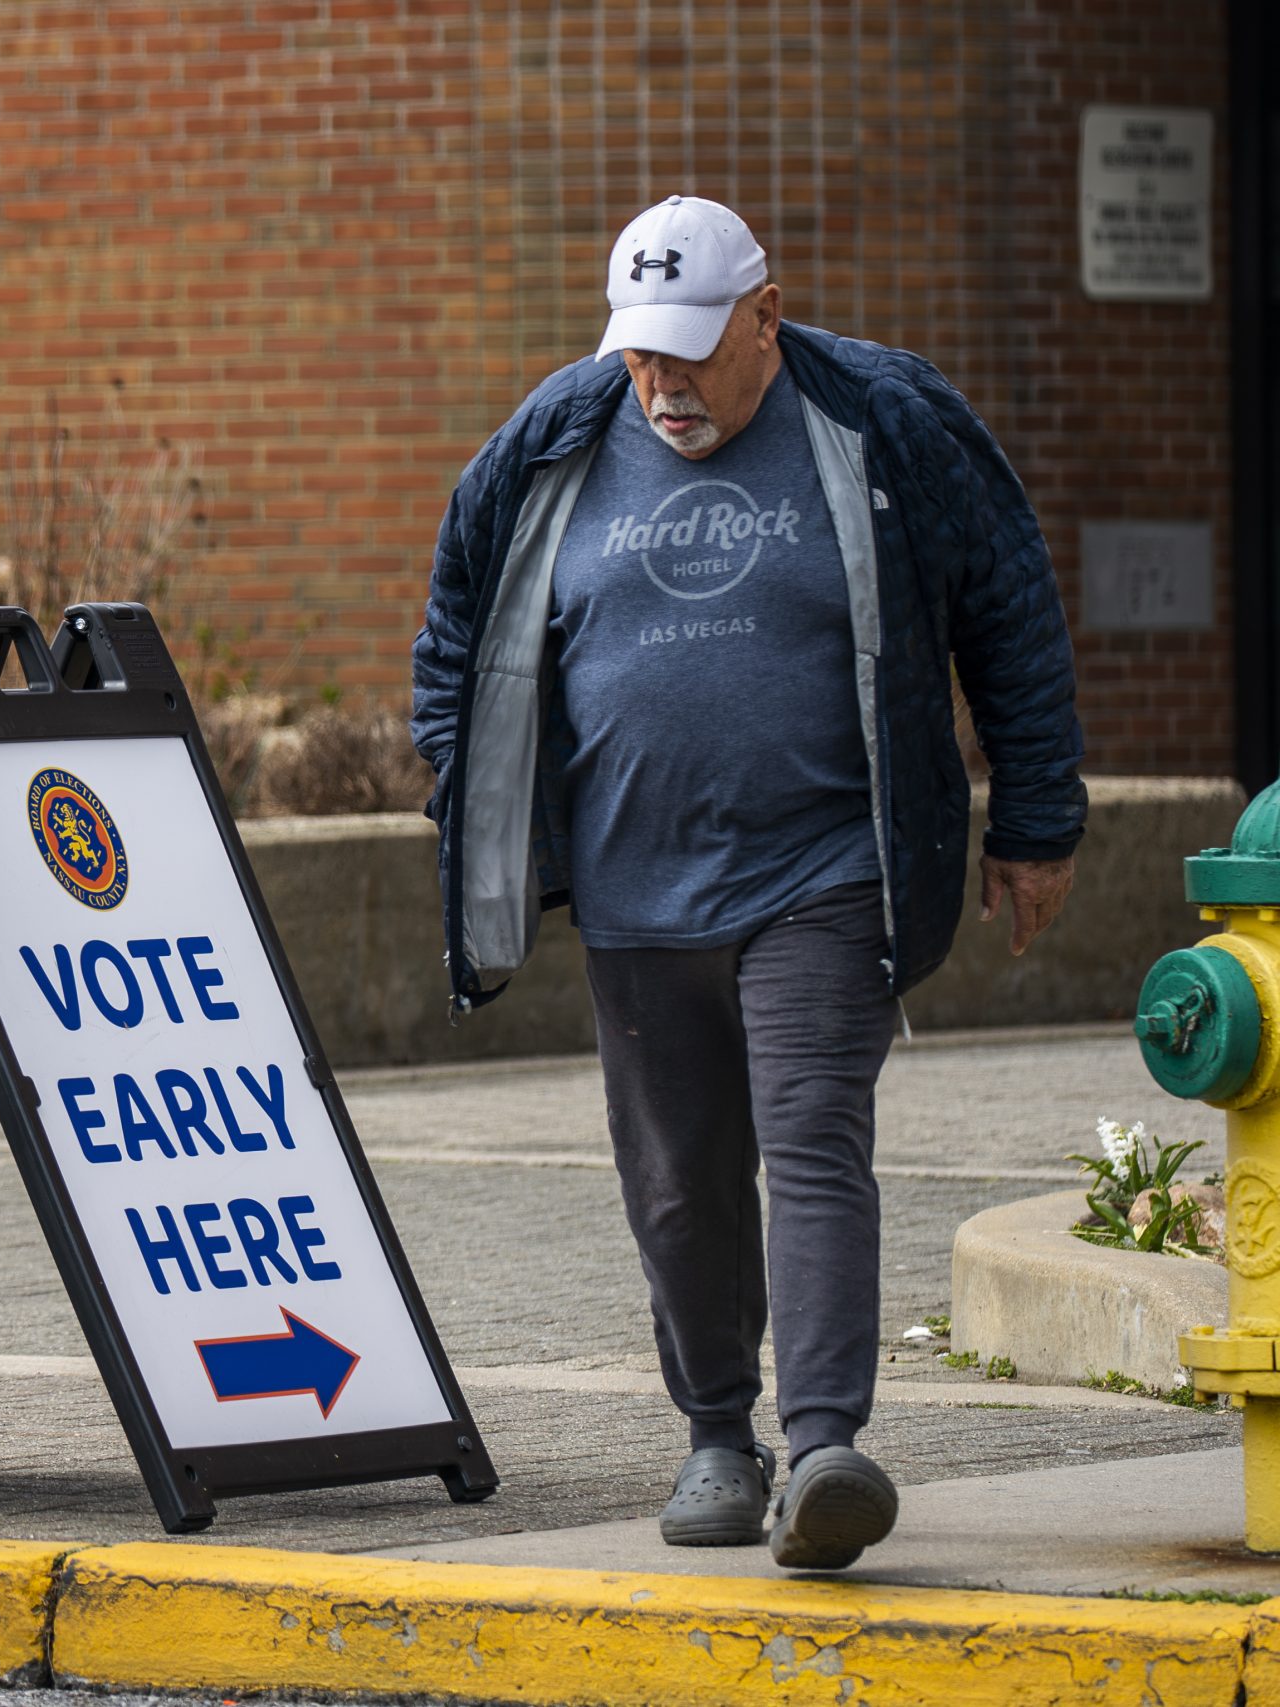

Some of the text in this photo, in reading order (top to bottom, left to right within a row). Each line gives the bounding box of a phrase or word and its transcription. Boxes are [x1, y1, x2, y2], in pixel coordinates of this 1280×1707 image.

[601, 498, 800, 557] Hard Rock
[673, 557, 732, 578] HOTEL
[640, 616, 756, 646] LAS VEGAS
[32, 772, 113, 831] BOARD OF ELECTIONS
[44, 852, 86, 901] NASSAU
[18, 935, 240, 1032] VOTE
[57, 1064, 296, 1164] EARLY
[124, 1195, 342, 1295] HERE
